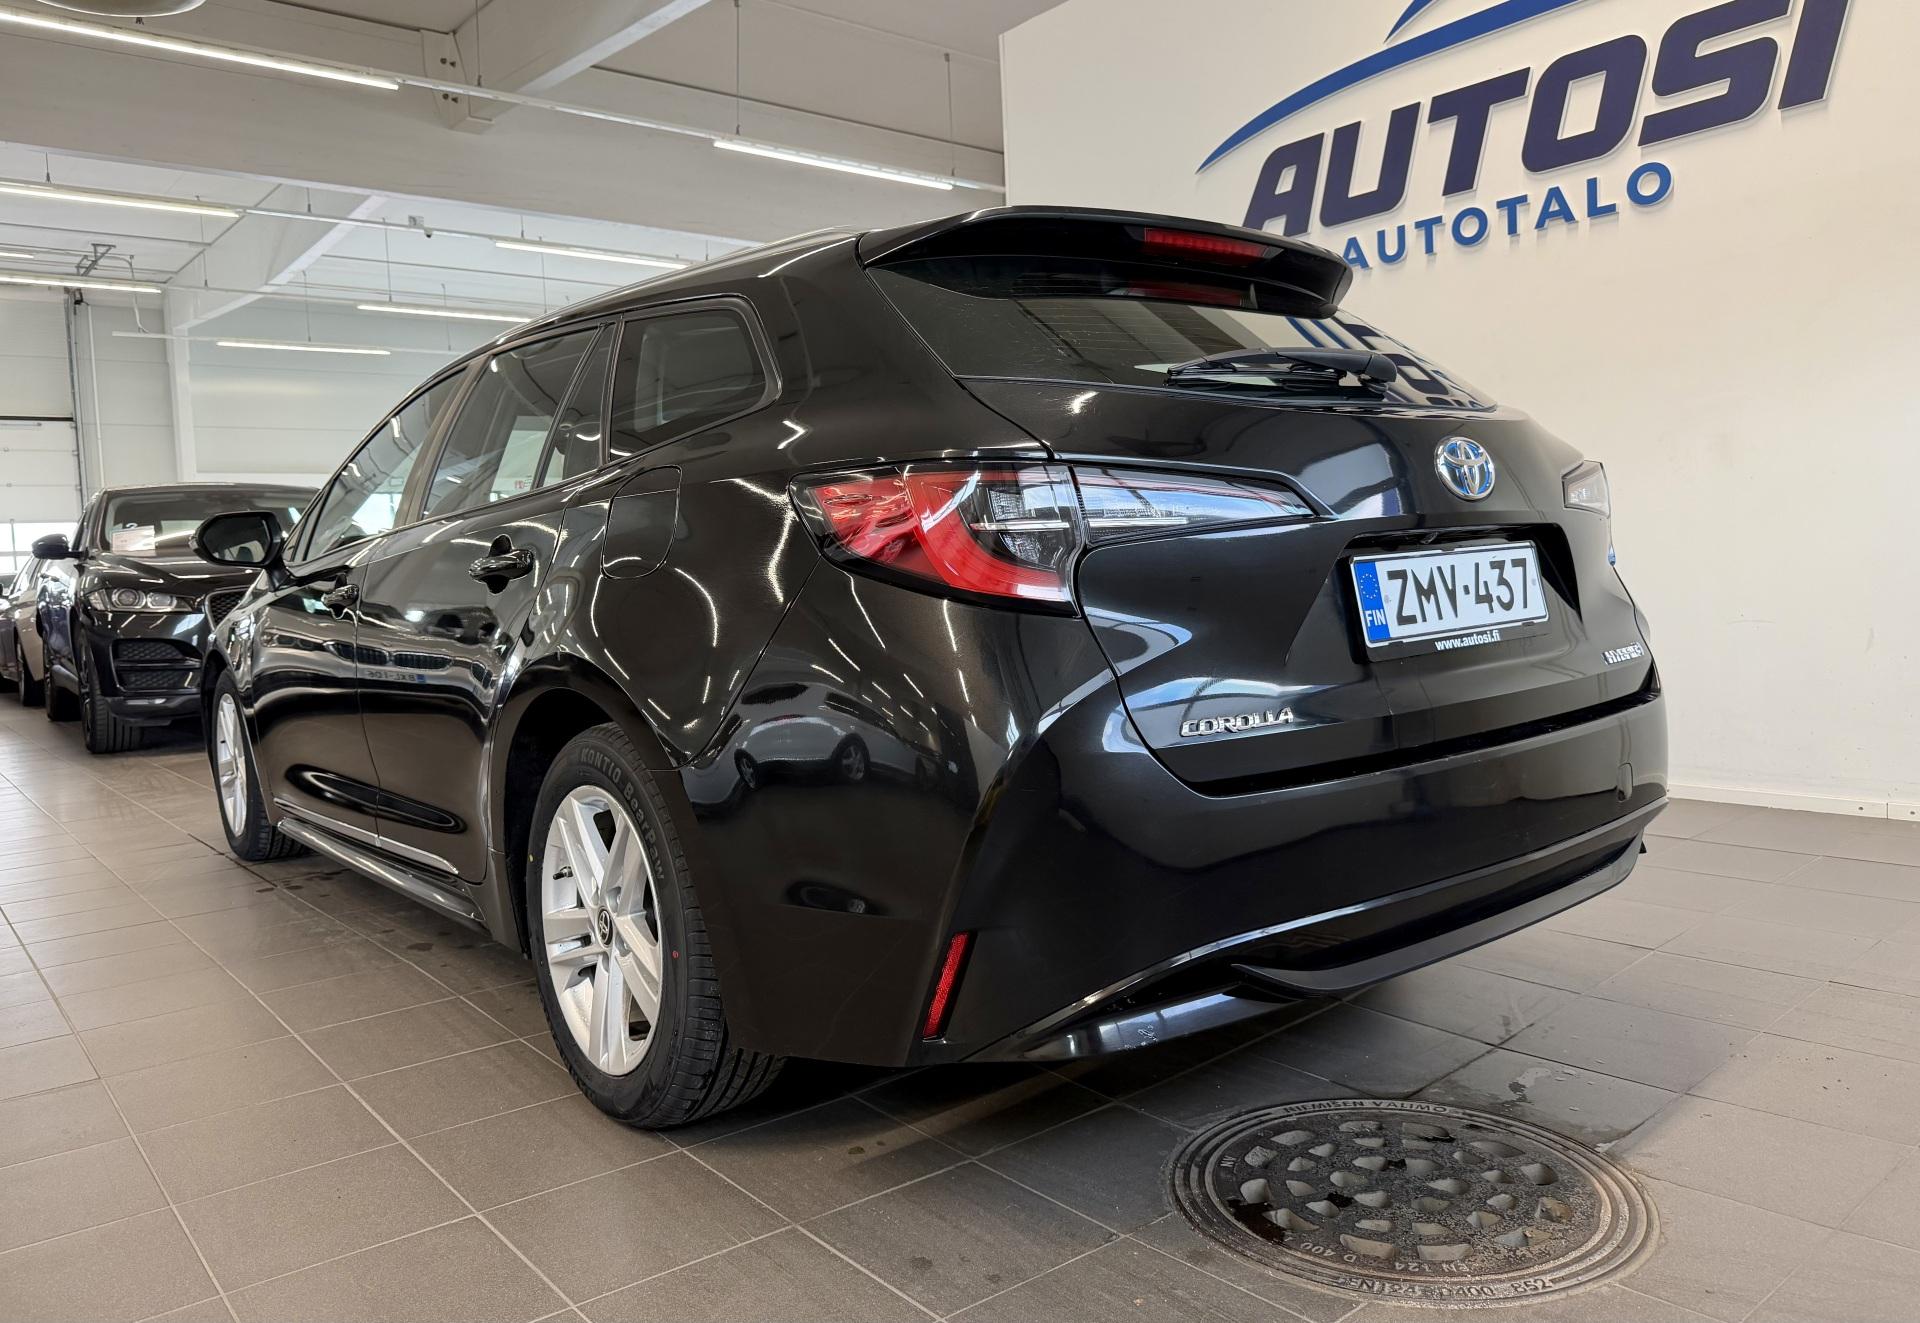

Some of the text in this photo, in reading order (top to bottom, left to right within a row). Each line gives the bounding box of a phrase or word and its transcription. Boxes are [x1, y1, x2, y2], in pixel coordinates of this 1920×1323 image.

[1242, 0, 1850, 237] AUTOSI
[1343, 161, 1673, 270] AUTOTALO
[1364, 609, 1387, 628] FIN
[1434, 629, 1501, 651] www.autosi.fi
[1180, 706, 1294, 737] COROLLA
[581, 747, 622, 784] KONTIO
[1371, 1100, 1447, 1114] VALIMO
